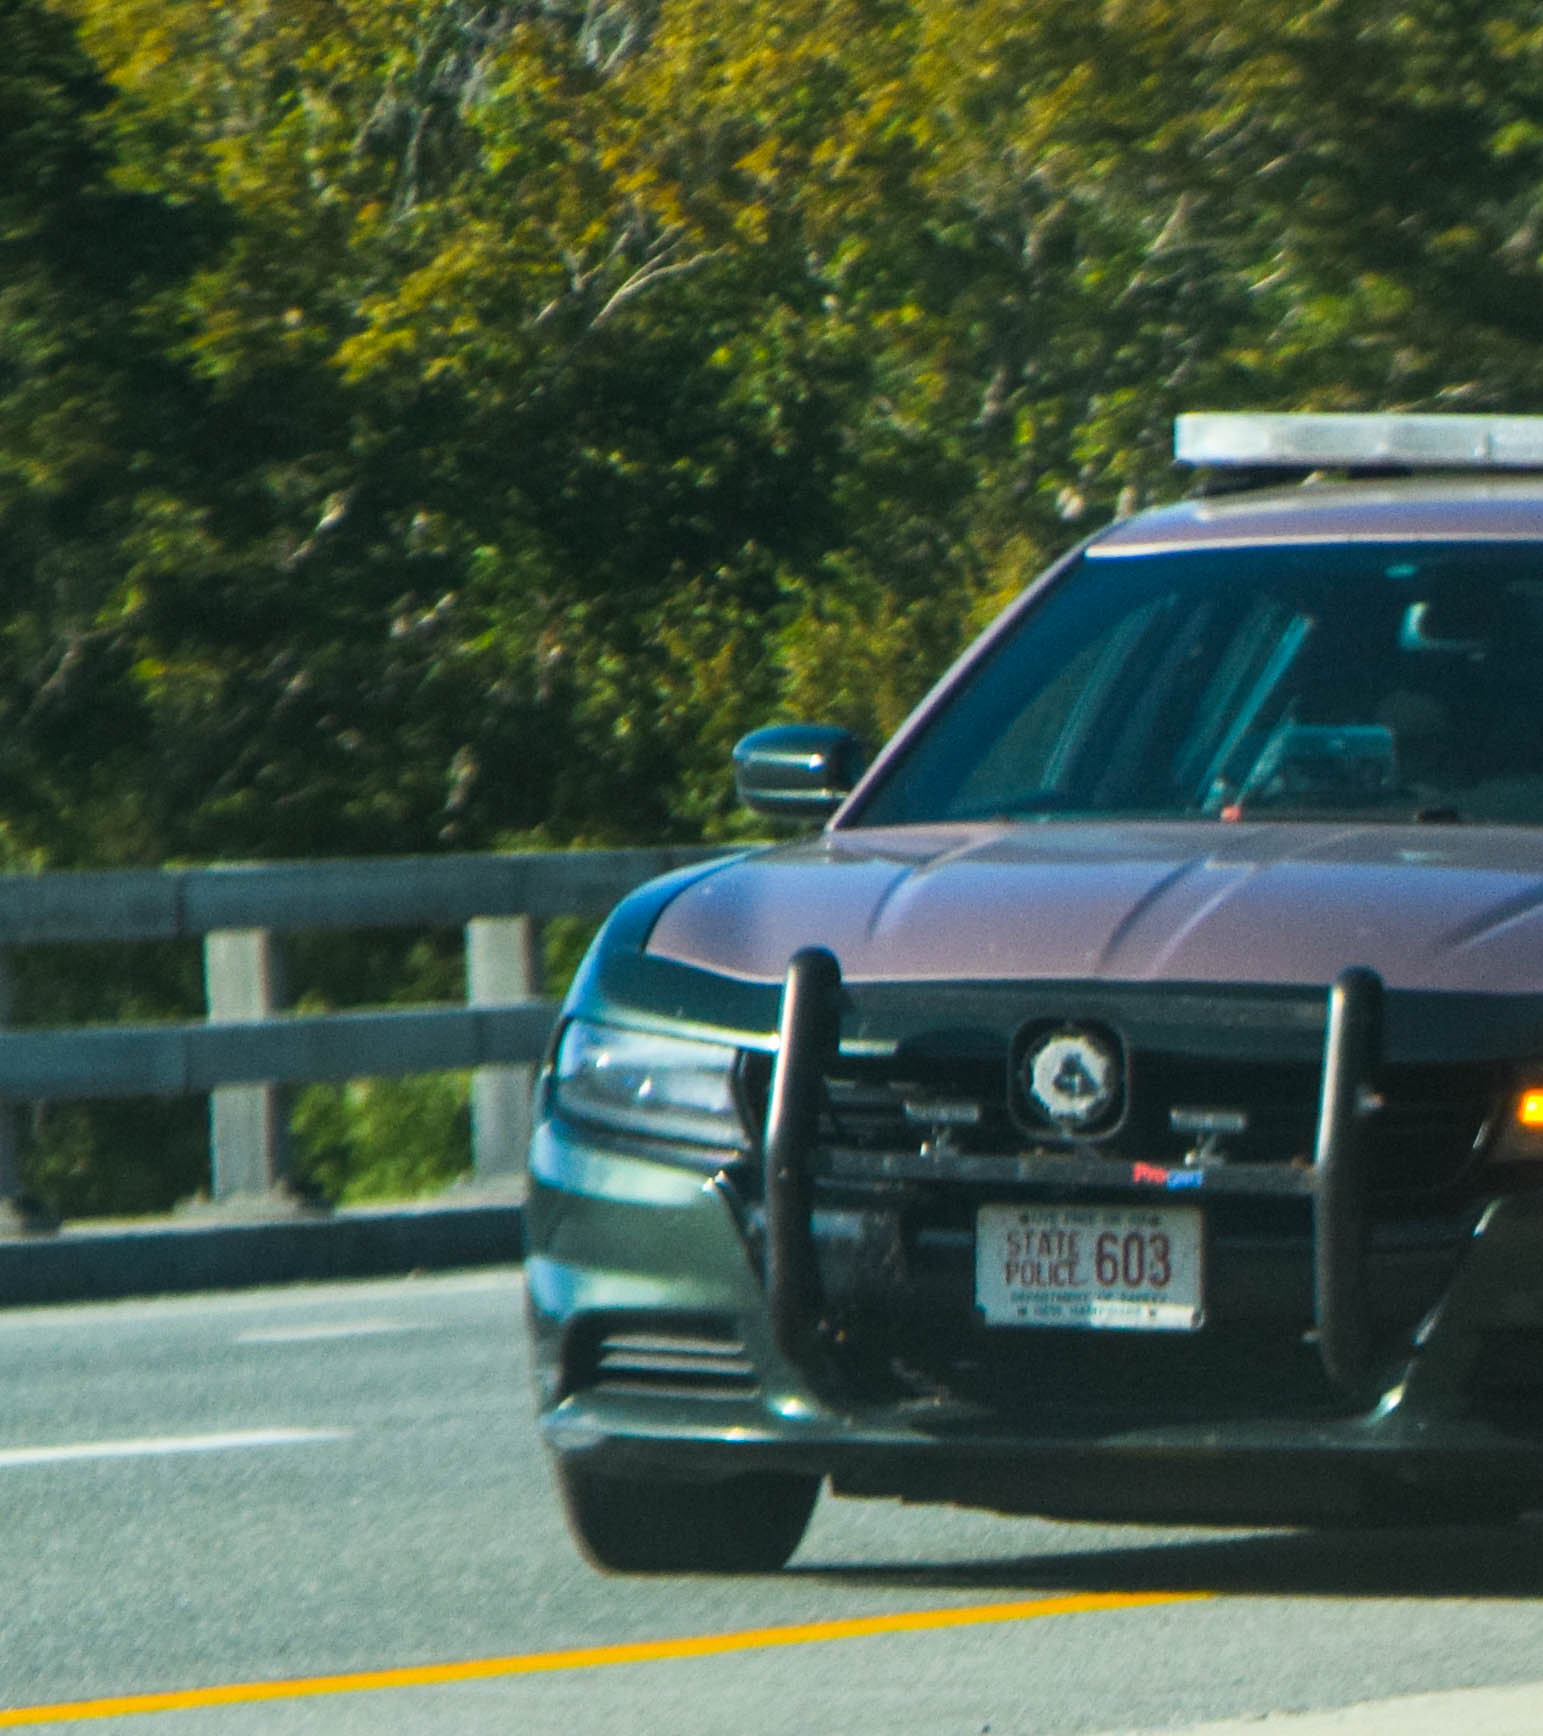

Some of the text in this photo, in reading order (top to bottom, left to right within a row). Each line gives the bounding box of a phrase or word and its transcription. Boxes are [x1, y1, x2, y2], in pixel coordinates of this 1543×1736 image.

[1006, 1229, 1080, 1257] STATE
[1004, 1257, 1086, 1287] POLICE
[1095, 1230, 1172, 1288] 603
